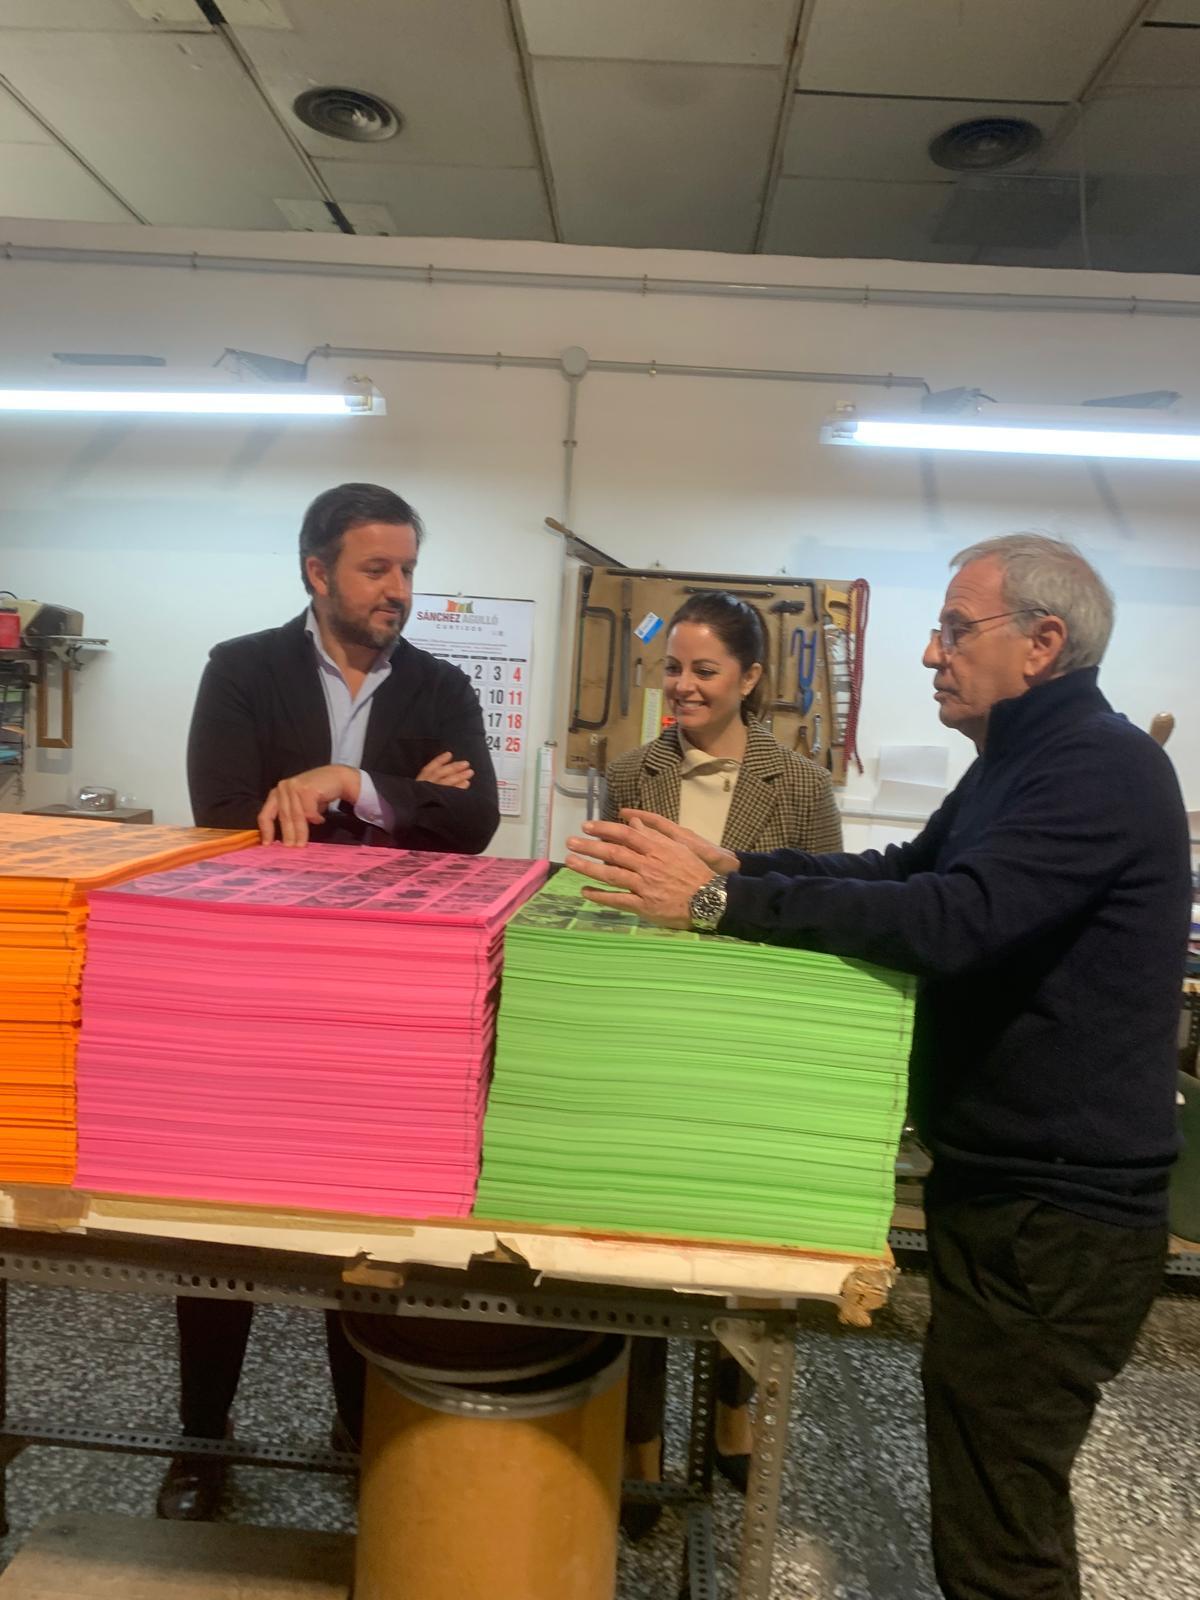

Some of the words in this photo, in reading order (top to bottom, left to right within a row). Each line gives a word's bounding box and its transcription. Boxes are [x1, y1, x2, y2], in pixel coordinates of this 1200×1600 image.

[416, 611, 460, 623] SÁNCHEZ
[474, 664, 482, 680] 2
[493, 666, 501, 681] 3
[513, 667, 521, 682] 4
[489, 690, 504, 705] 10
[509, 691, 522, 705] 11
[488, 713, 502, 728] 17
[507, 714, 522, 730] 18
[486, 736, 501, 751] 24
[505, 737, 520, 752] 25
